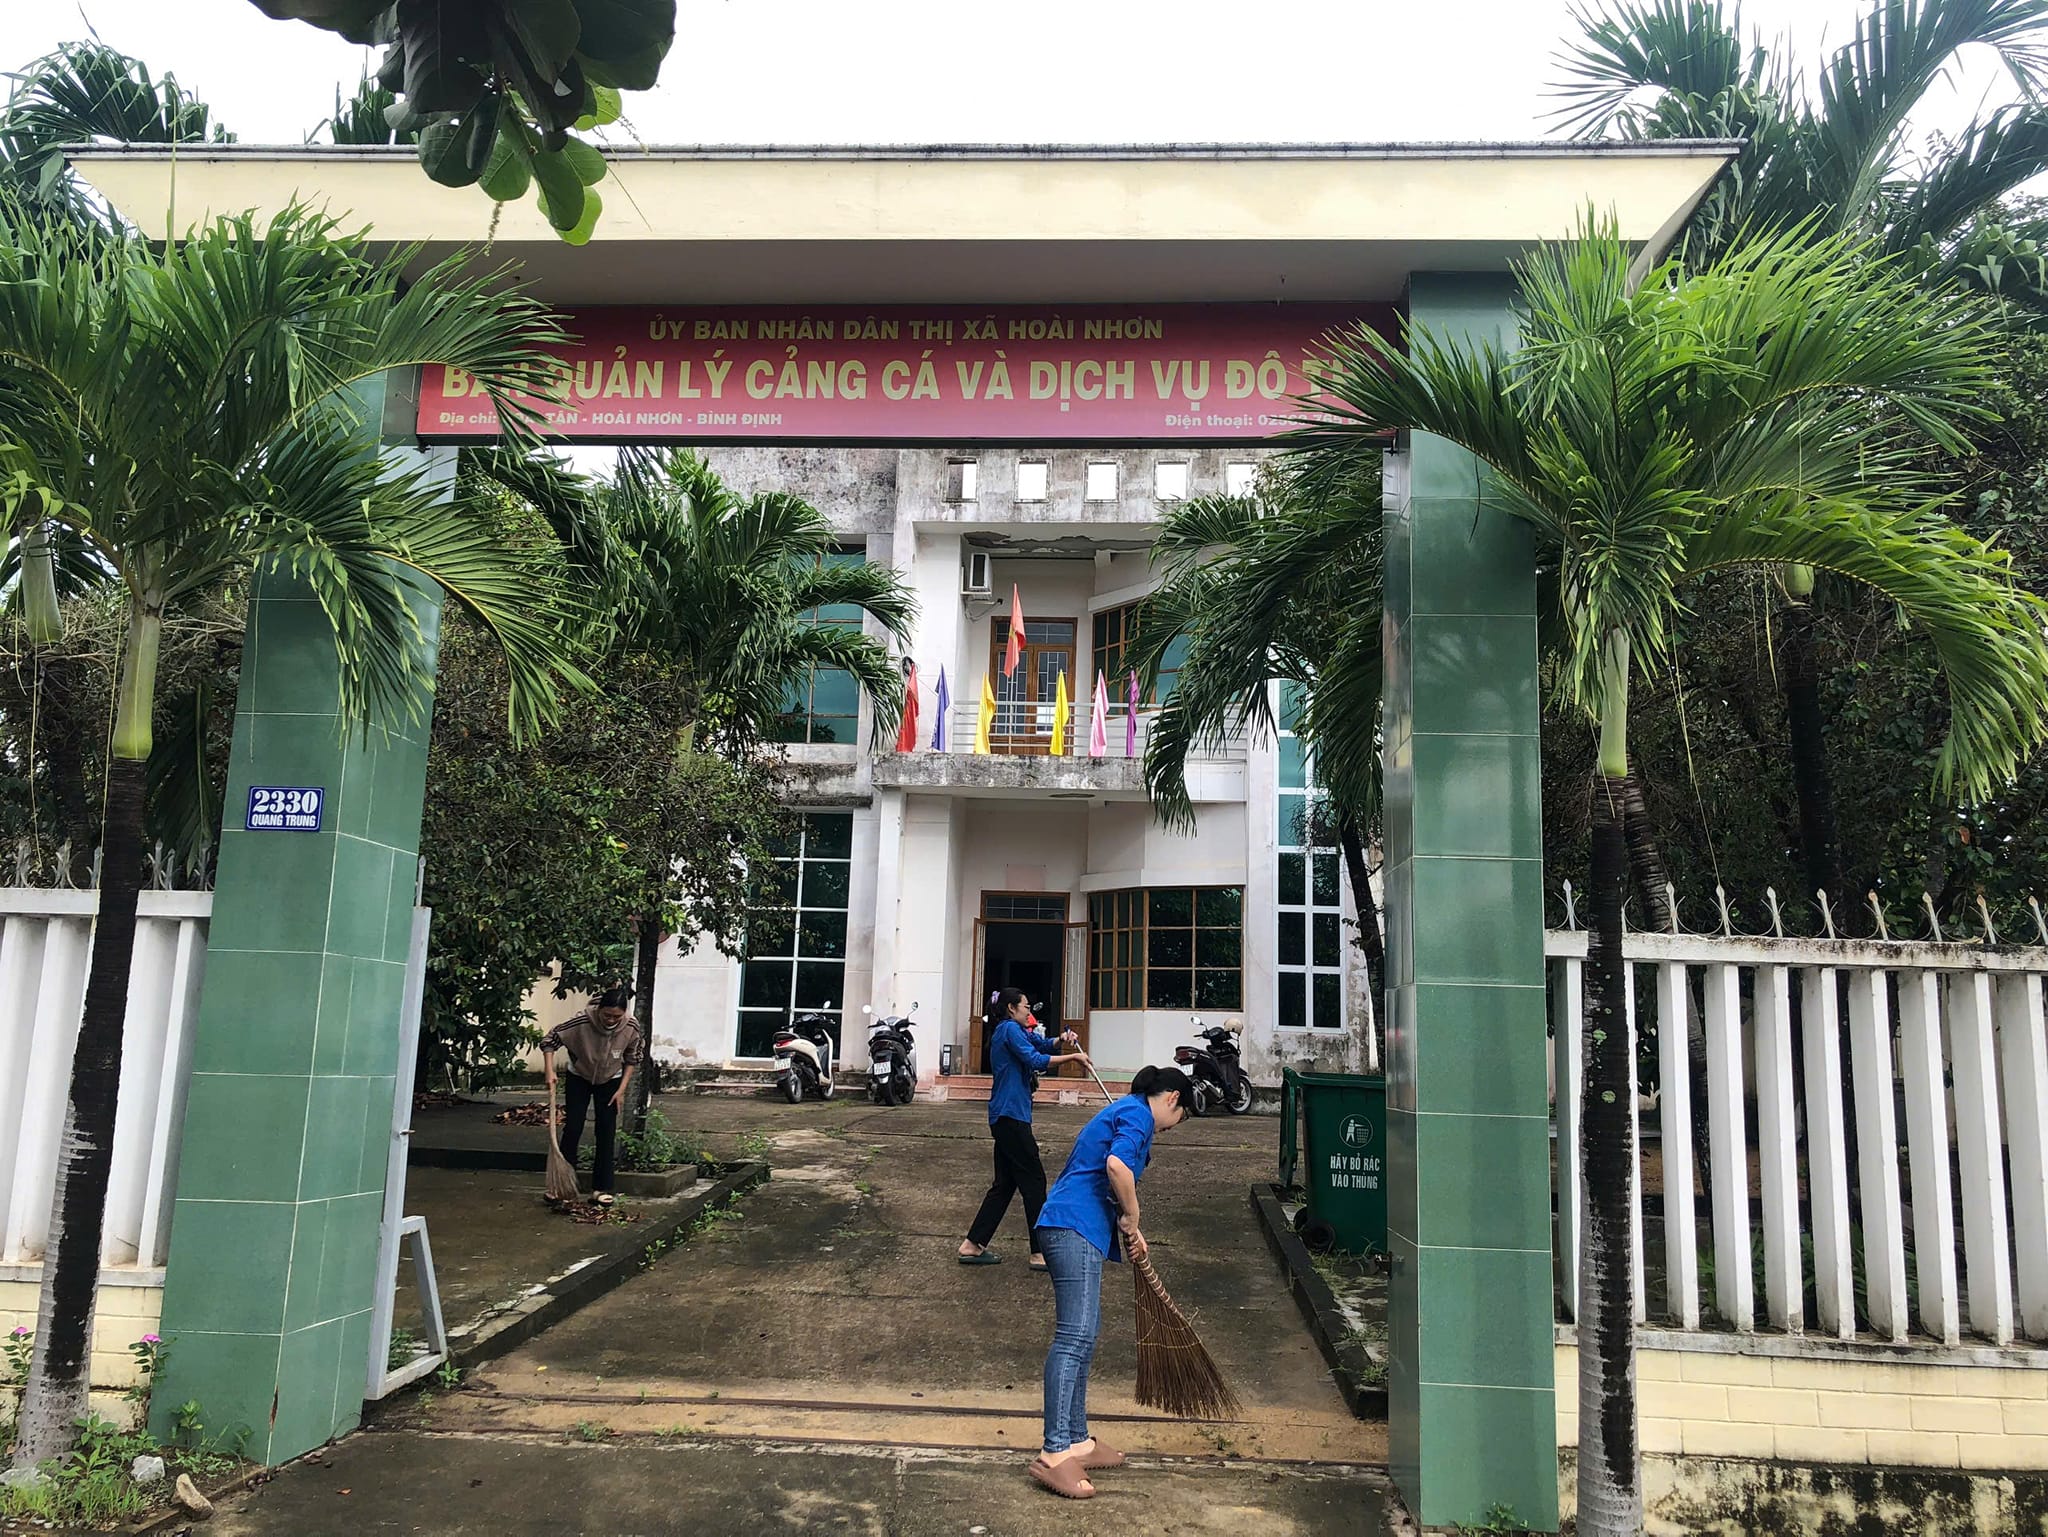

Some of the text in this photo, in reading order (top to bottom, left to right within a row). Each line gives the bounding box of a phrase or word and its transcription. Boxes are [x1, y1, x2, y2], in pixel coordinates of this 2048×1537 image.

[650, 313, 1163, 346] ỦY BAN NHÂN DÂN THỊ XÃ HOÀI NHƠN
[543, 345, 665, 401] QUẢN
[678, 349, 734, 399] LÝ
[745, 344, 867, 400] CẢNG
[881, 350, 941, 400] CÁ
[955, 349, 1014, 400] VÀ
[1029, 360, 1135, 412] DỊCH
[1150, 359, 1210, 412] VỤ
[1224, 350, 1288, 400] ĐÔ
[439, 412, 465, 427] Địa
[469, 411, 497, 424] chỉ:
[592, 410, 631, 425] HOÀI
[636, 410, 683, 425] NHƠN
[697, 410, 737, 425] BÌNH
[741, 413, 783, 428] ĐỊNH
[1165, 414, 1201, 429] Điện
[1207, 414, 1253, 429] thoại:
[252, 790, 318, 814] 2330
[251, 814, 317, 828] QUANG TRUNG
[1330, 1152, 1380, 1171] HÃY BỎ RÁC
[1331, 1170, 1378, 1190] VÀO THÙNG
